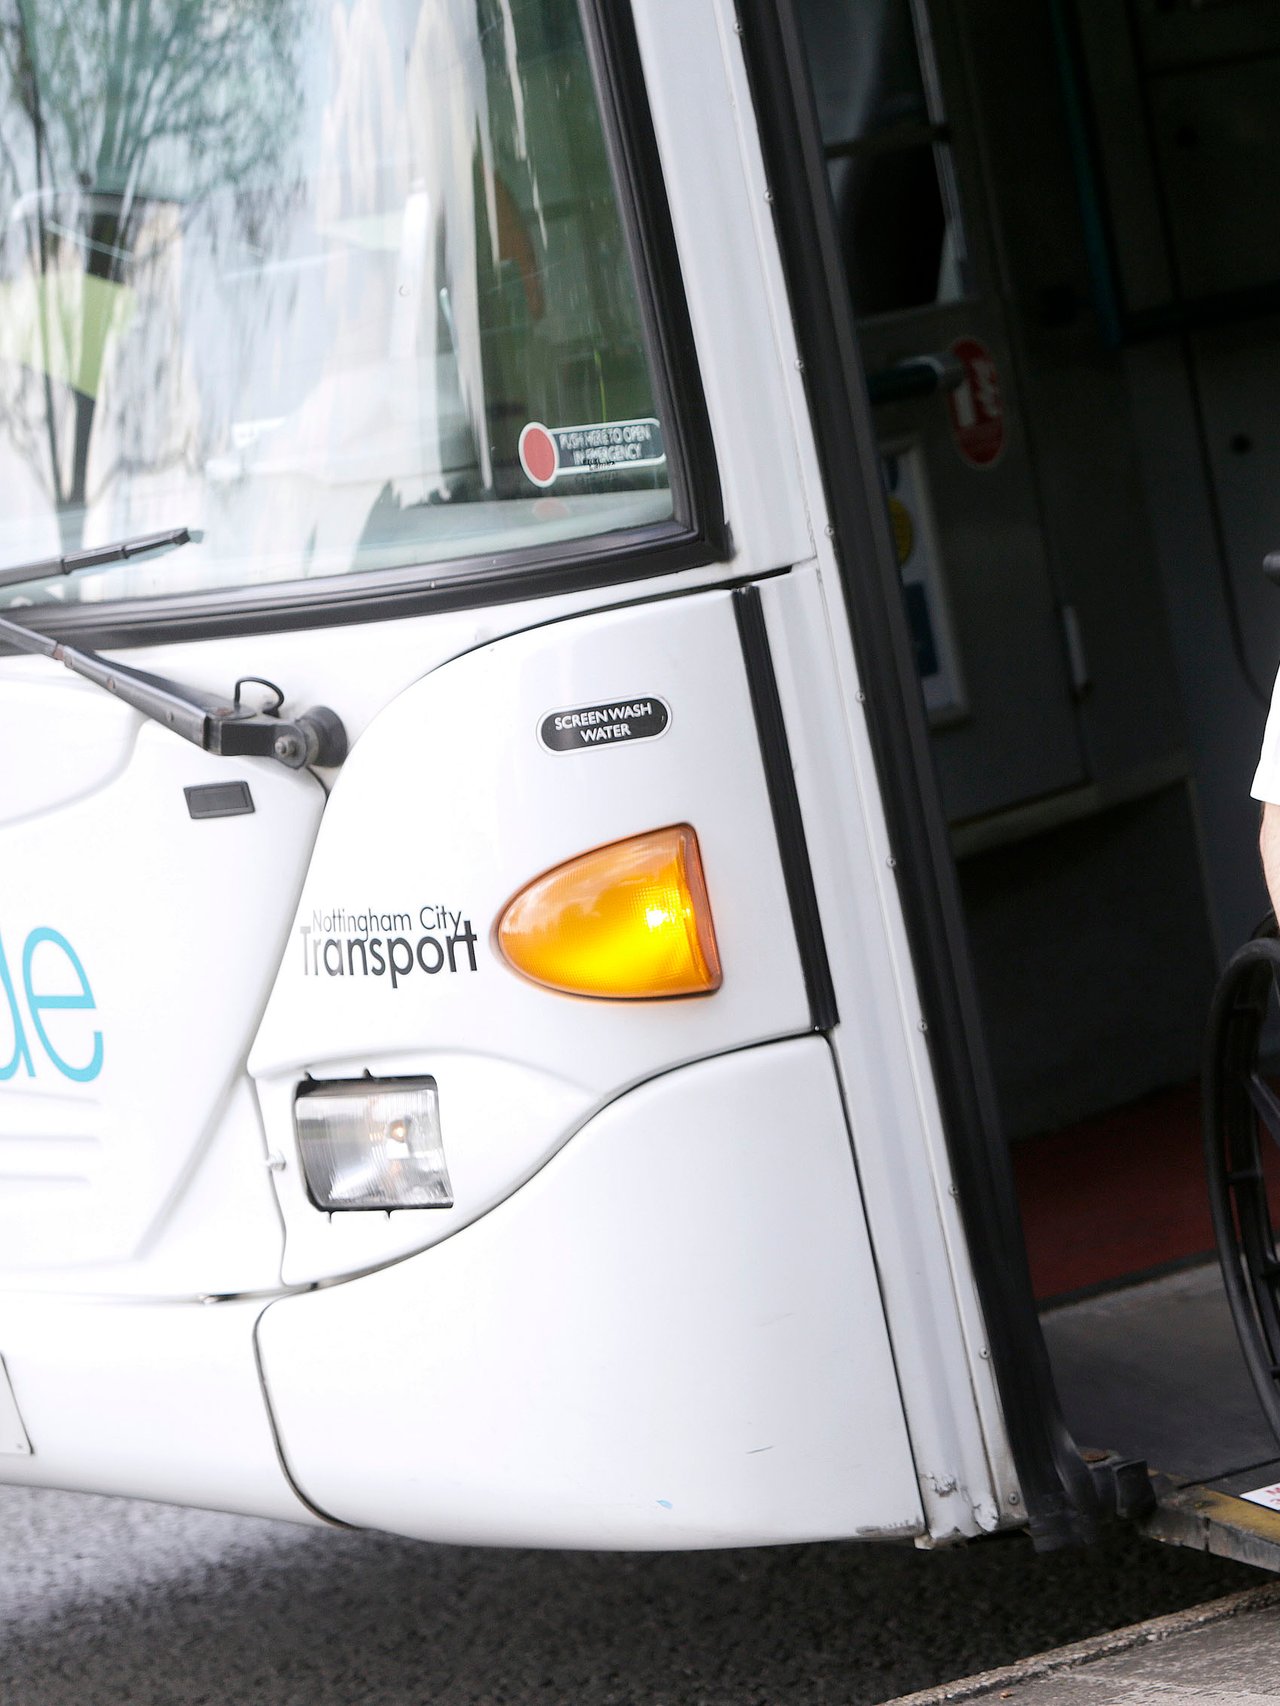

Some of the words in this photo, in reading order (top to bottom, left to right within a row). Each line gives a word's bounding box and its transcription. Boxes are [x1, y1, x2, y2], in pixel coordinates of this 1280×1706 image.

[623, 424, 652, 443] OPEN
[580, 723, 631, 743] WATER
[312, 906, 412, 943] Nottingham
[419, 905, 462, 940] City
[300, 919, 478, 989] Transport
